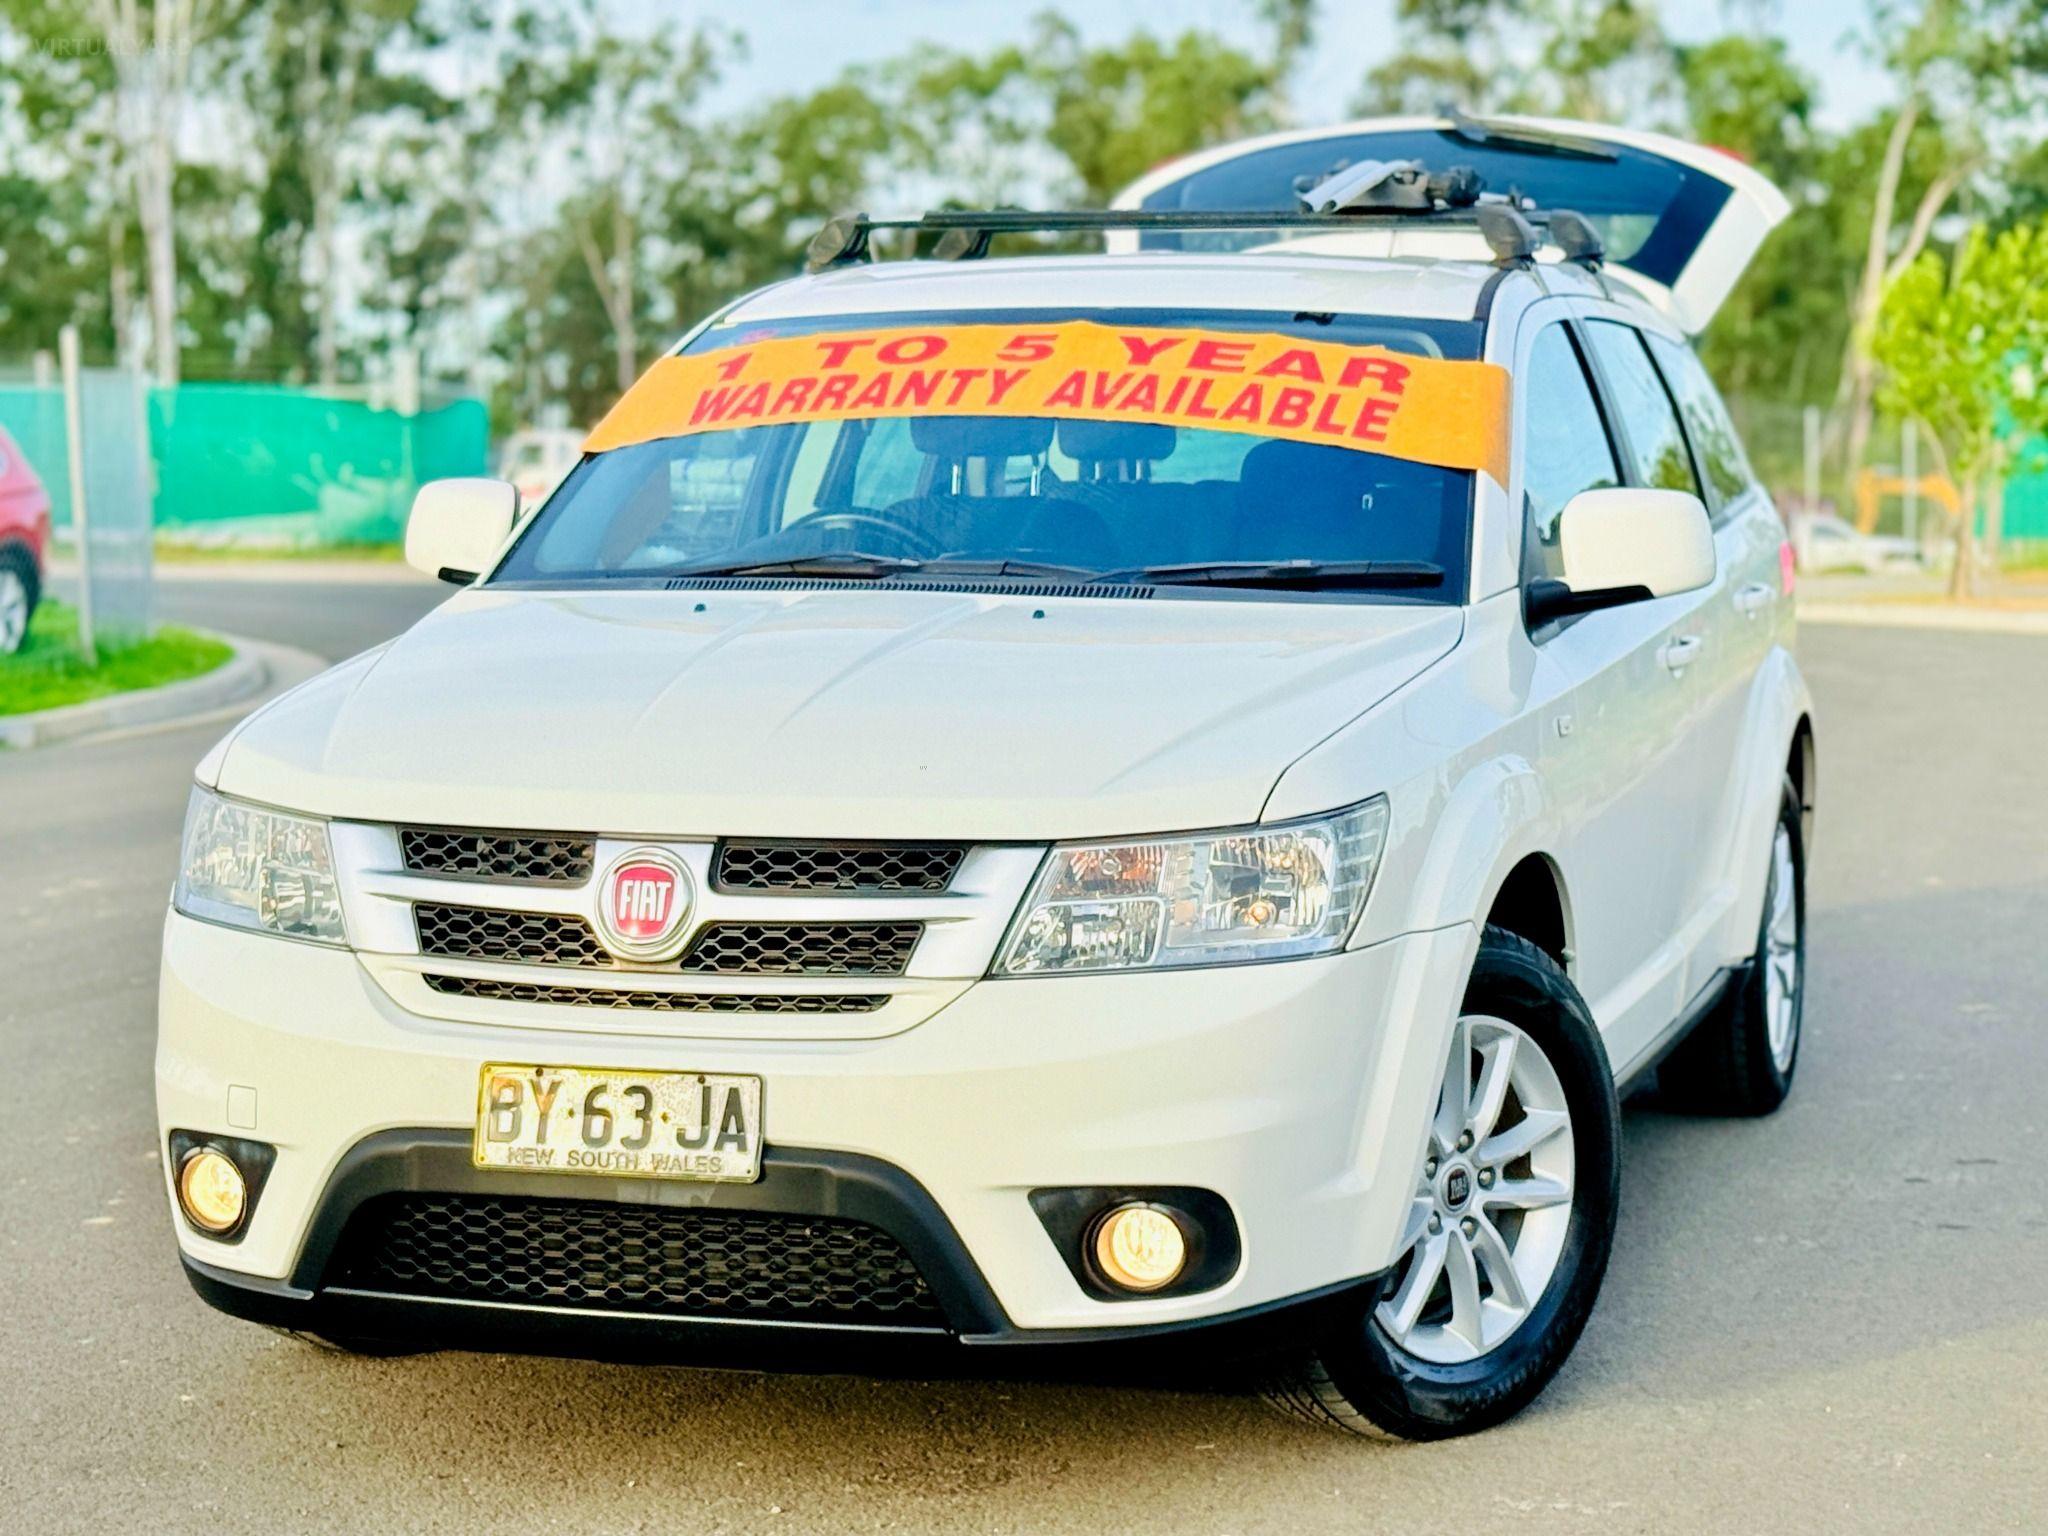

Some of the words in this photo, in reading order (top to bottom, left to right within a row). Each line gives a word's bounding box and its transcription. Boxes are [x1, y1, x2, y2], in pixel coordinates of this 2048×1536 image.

[717, 352, 753, 382] 1
[816, 335, 949, 370] TO
[996, 334, 1059, 362] 5
[1119, 336, 1413, 395] YEAR
[688, 368, 1032, 426] WARRANTY
[1043, 369, 1400, 442] AVAILABLE
[619, 879, 672, 922] FIAT
[507, 1147, 554, 1166] NEW
[566, 1150, 640, 1171] SOUTH
[651, 1152, 722, 1174] WALES
